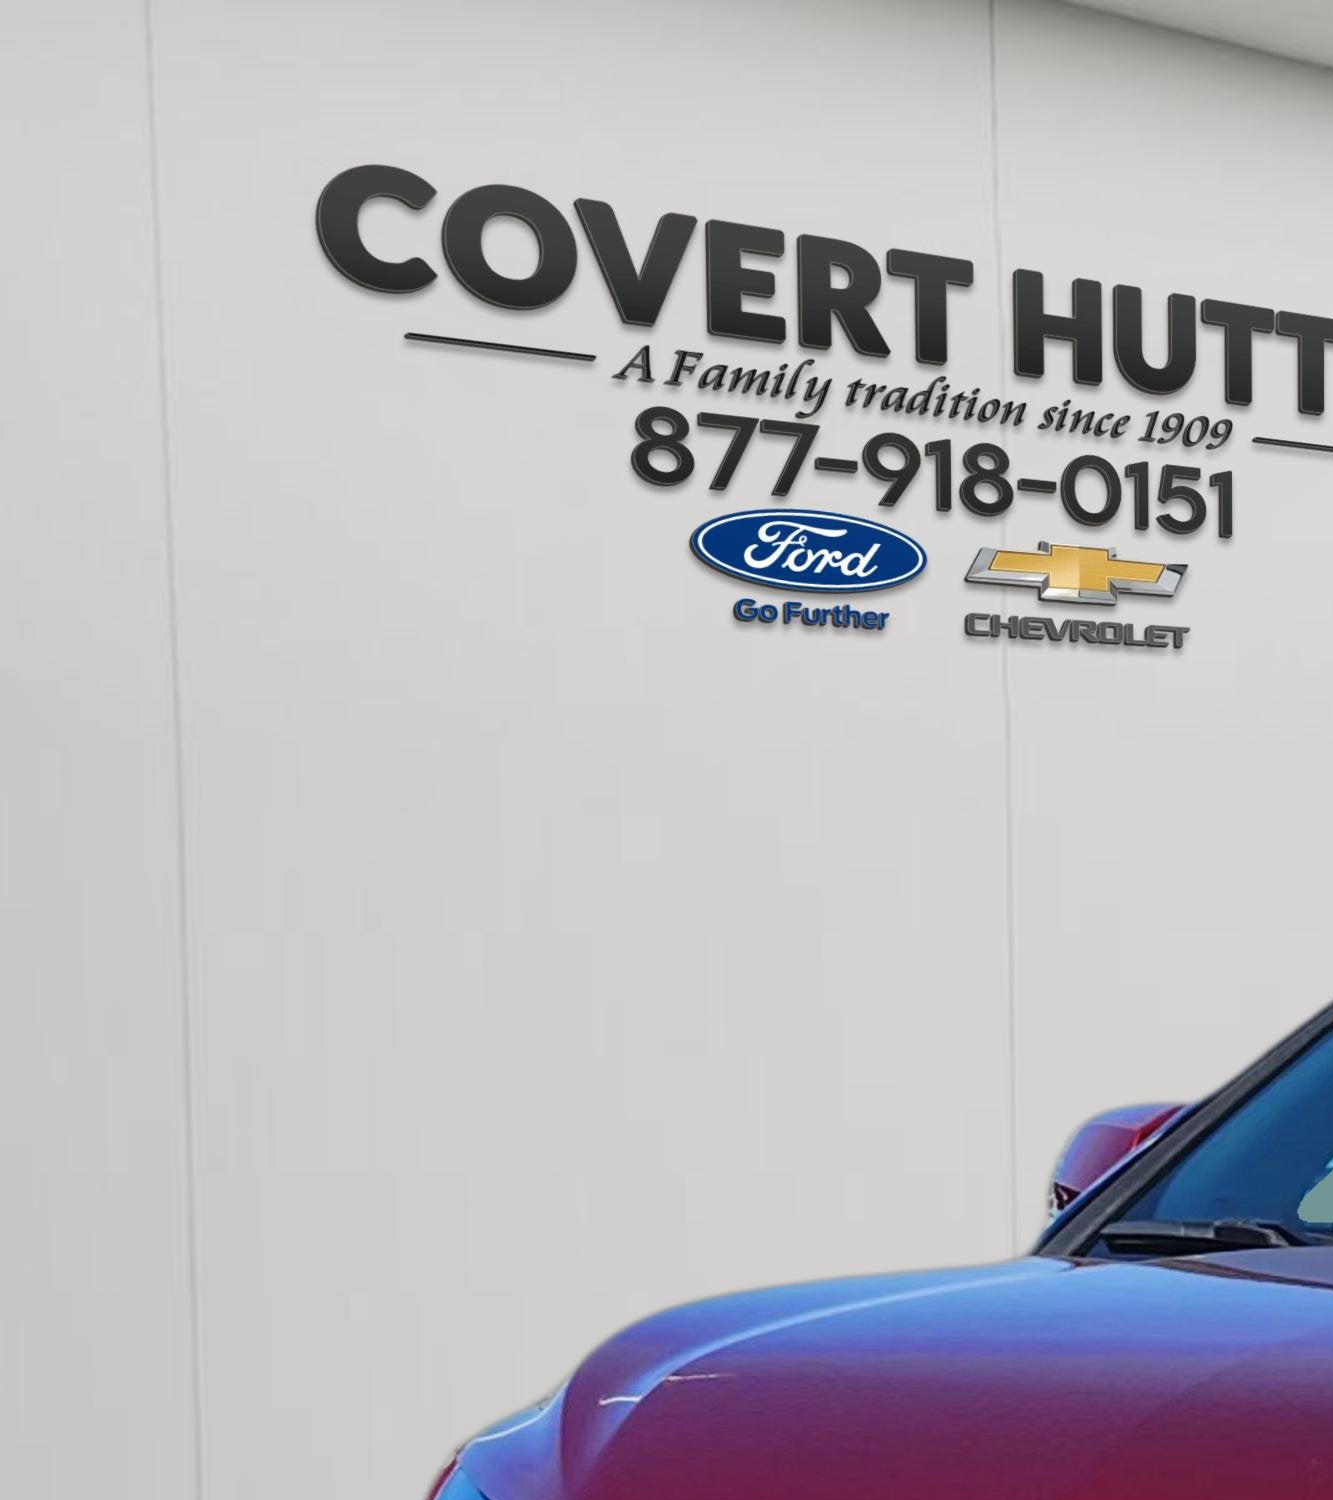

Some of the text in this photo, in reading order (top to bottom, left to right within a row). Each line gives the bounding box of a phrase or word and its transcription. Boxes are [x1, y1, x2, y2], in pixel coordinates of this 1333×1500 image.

[315, 164, 973, 365] COVERT
[612, 344, 1234, 450] A Family tradition since 1909
[630, 405, 1234, 540] 877-918-0151
[743, 519, 881, 579] Ford
[733, 597, 890, 632] Go Further
[964, 611, 1191, 650] CHEVROLET
